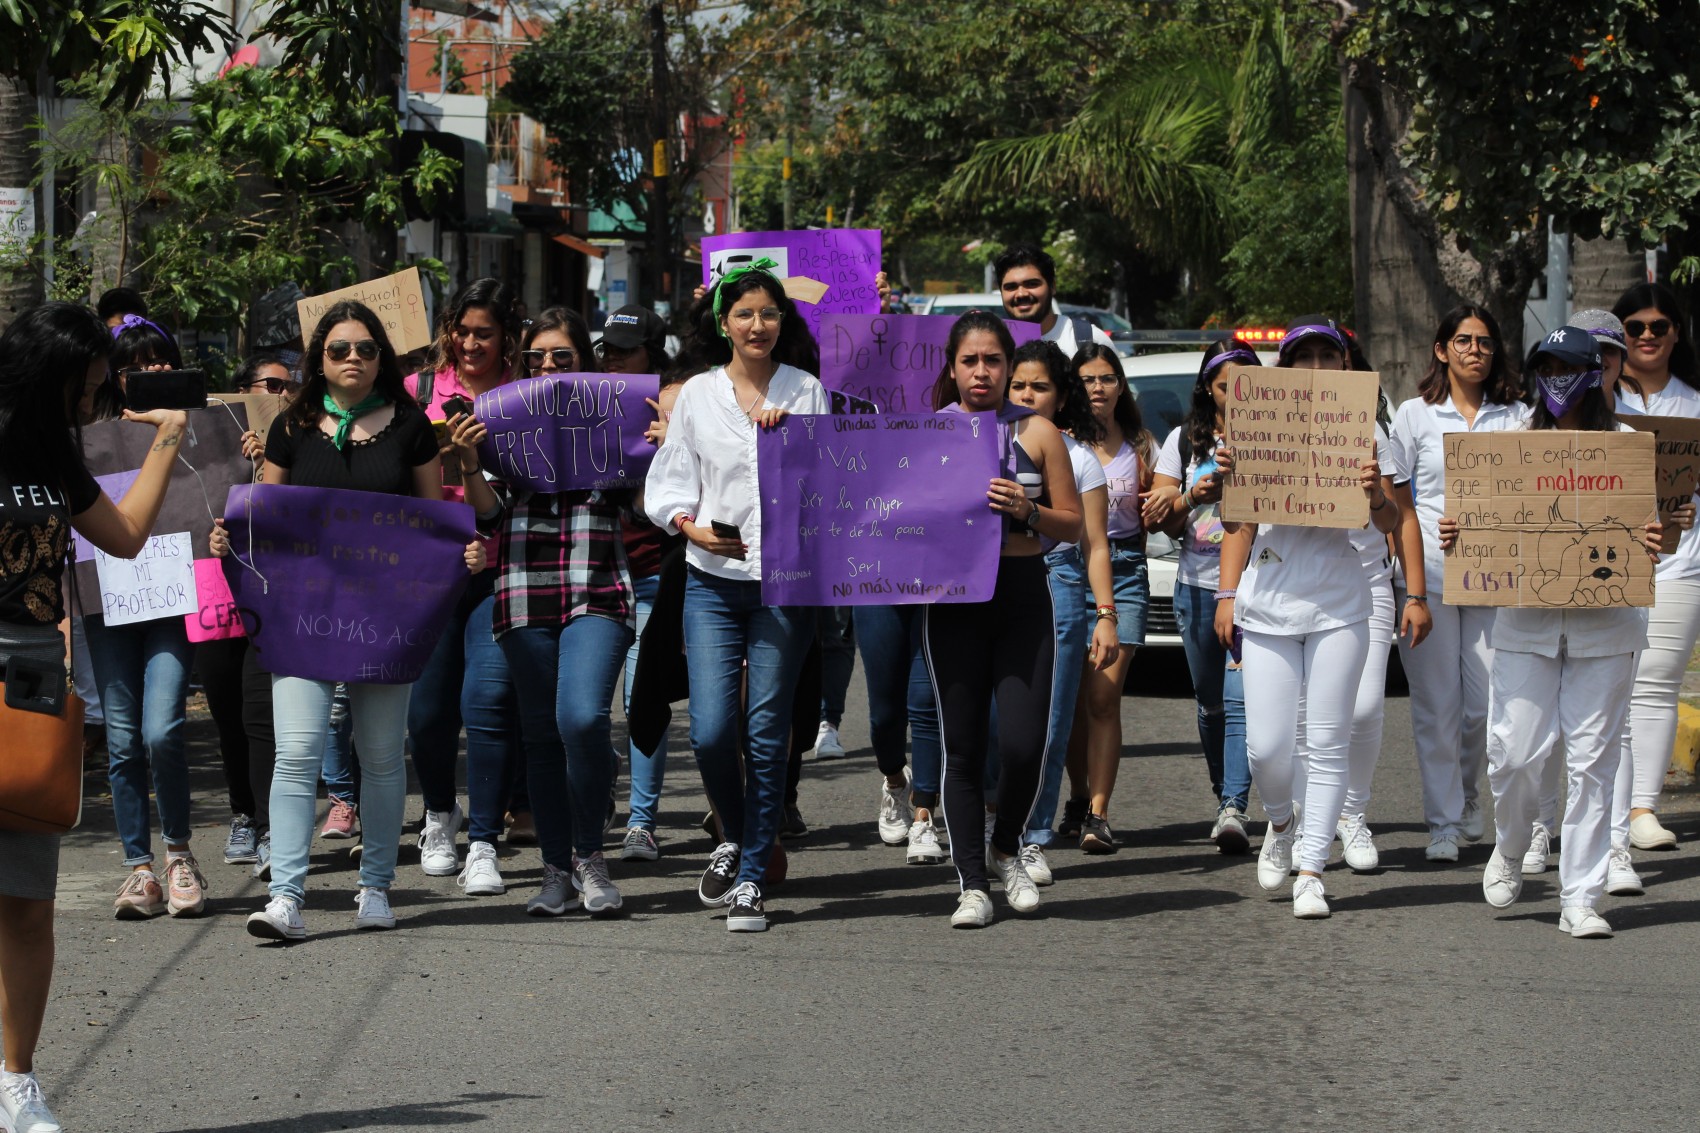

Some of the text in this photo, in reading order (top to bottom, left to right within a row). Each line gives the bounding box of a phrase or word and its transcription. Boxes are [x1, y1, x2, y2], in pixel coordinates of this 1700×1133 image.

[832, 269, 859, 284] las
[803, 283, 877, 305] ujeres
[831, 322, 870, 371] De
[517, 378, 627, 420] VIOLADOR
[1234, 373, 1337, 414] Quiero que mi
[833, 417, 877, 433] Unidas
[924, 416, 955, 431] más
[1230, 406, 1278, 422] mamá
[1286, 410, 1308, 423] me
[1358, 410, 1368, 424] a
[1230, 422, 1371, 449] buscar mi vestido de
[494, 418, 625, 483] ERES TÚ!
[898, 455, 909, 469] a
[1311, 450, 1332, 469] No
[1336, 457, 1361, 473] que
[1445, 438, 1607, 471] ¿Cómo le explican
[1232, 469, 1361, 493] la ayuden a buscar
[1451, 467, 1624, 508] que me mataron
[797, 478, 824, 508] Ser
[836, 485, 853, 511] la
[1253, 492, 1336, 520] mi Cuerpo
[371, 508, 437, 530] están
[1457, 501, 1535, 528] antes de
[799, 520, 925, 544] que te dé la gana
[1453, 537, 1519, 569] llegar a
[131, 561, 153, 583] MI
[847, 556, 882, 578] Ser!
[103, 582, 189, 618] PROFESOR
[832, 577, 967, 598] No más violencia
